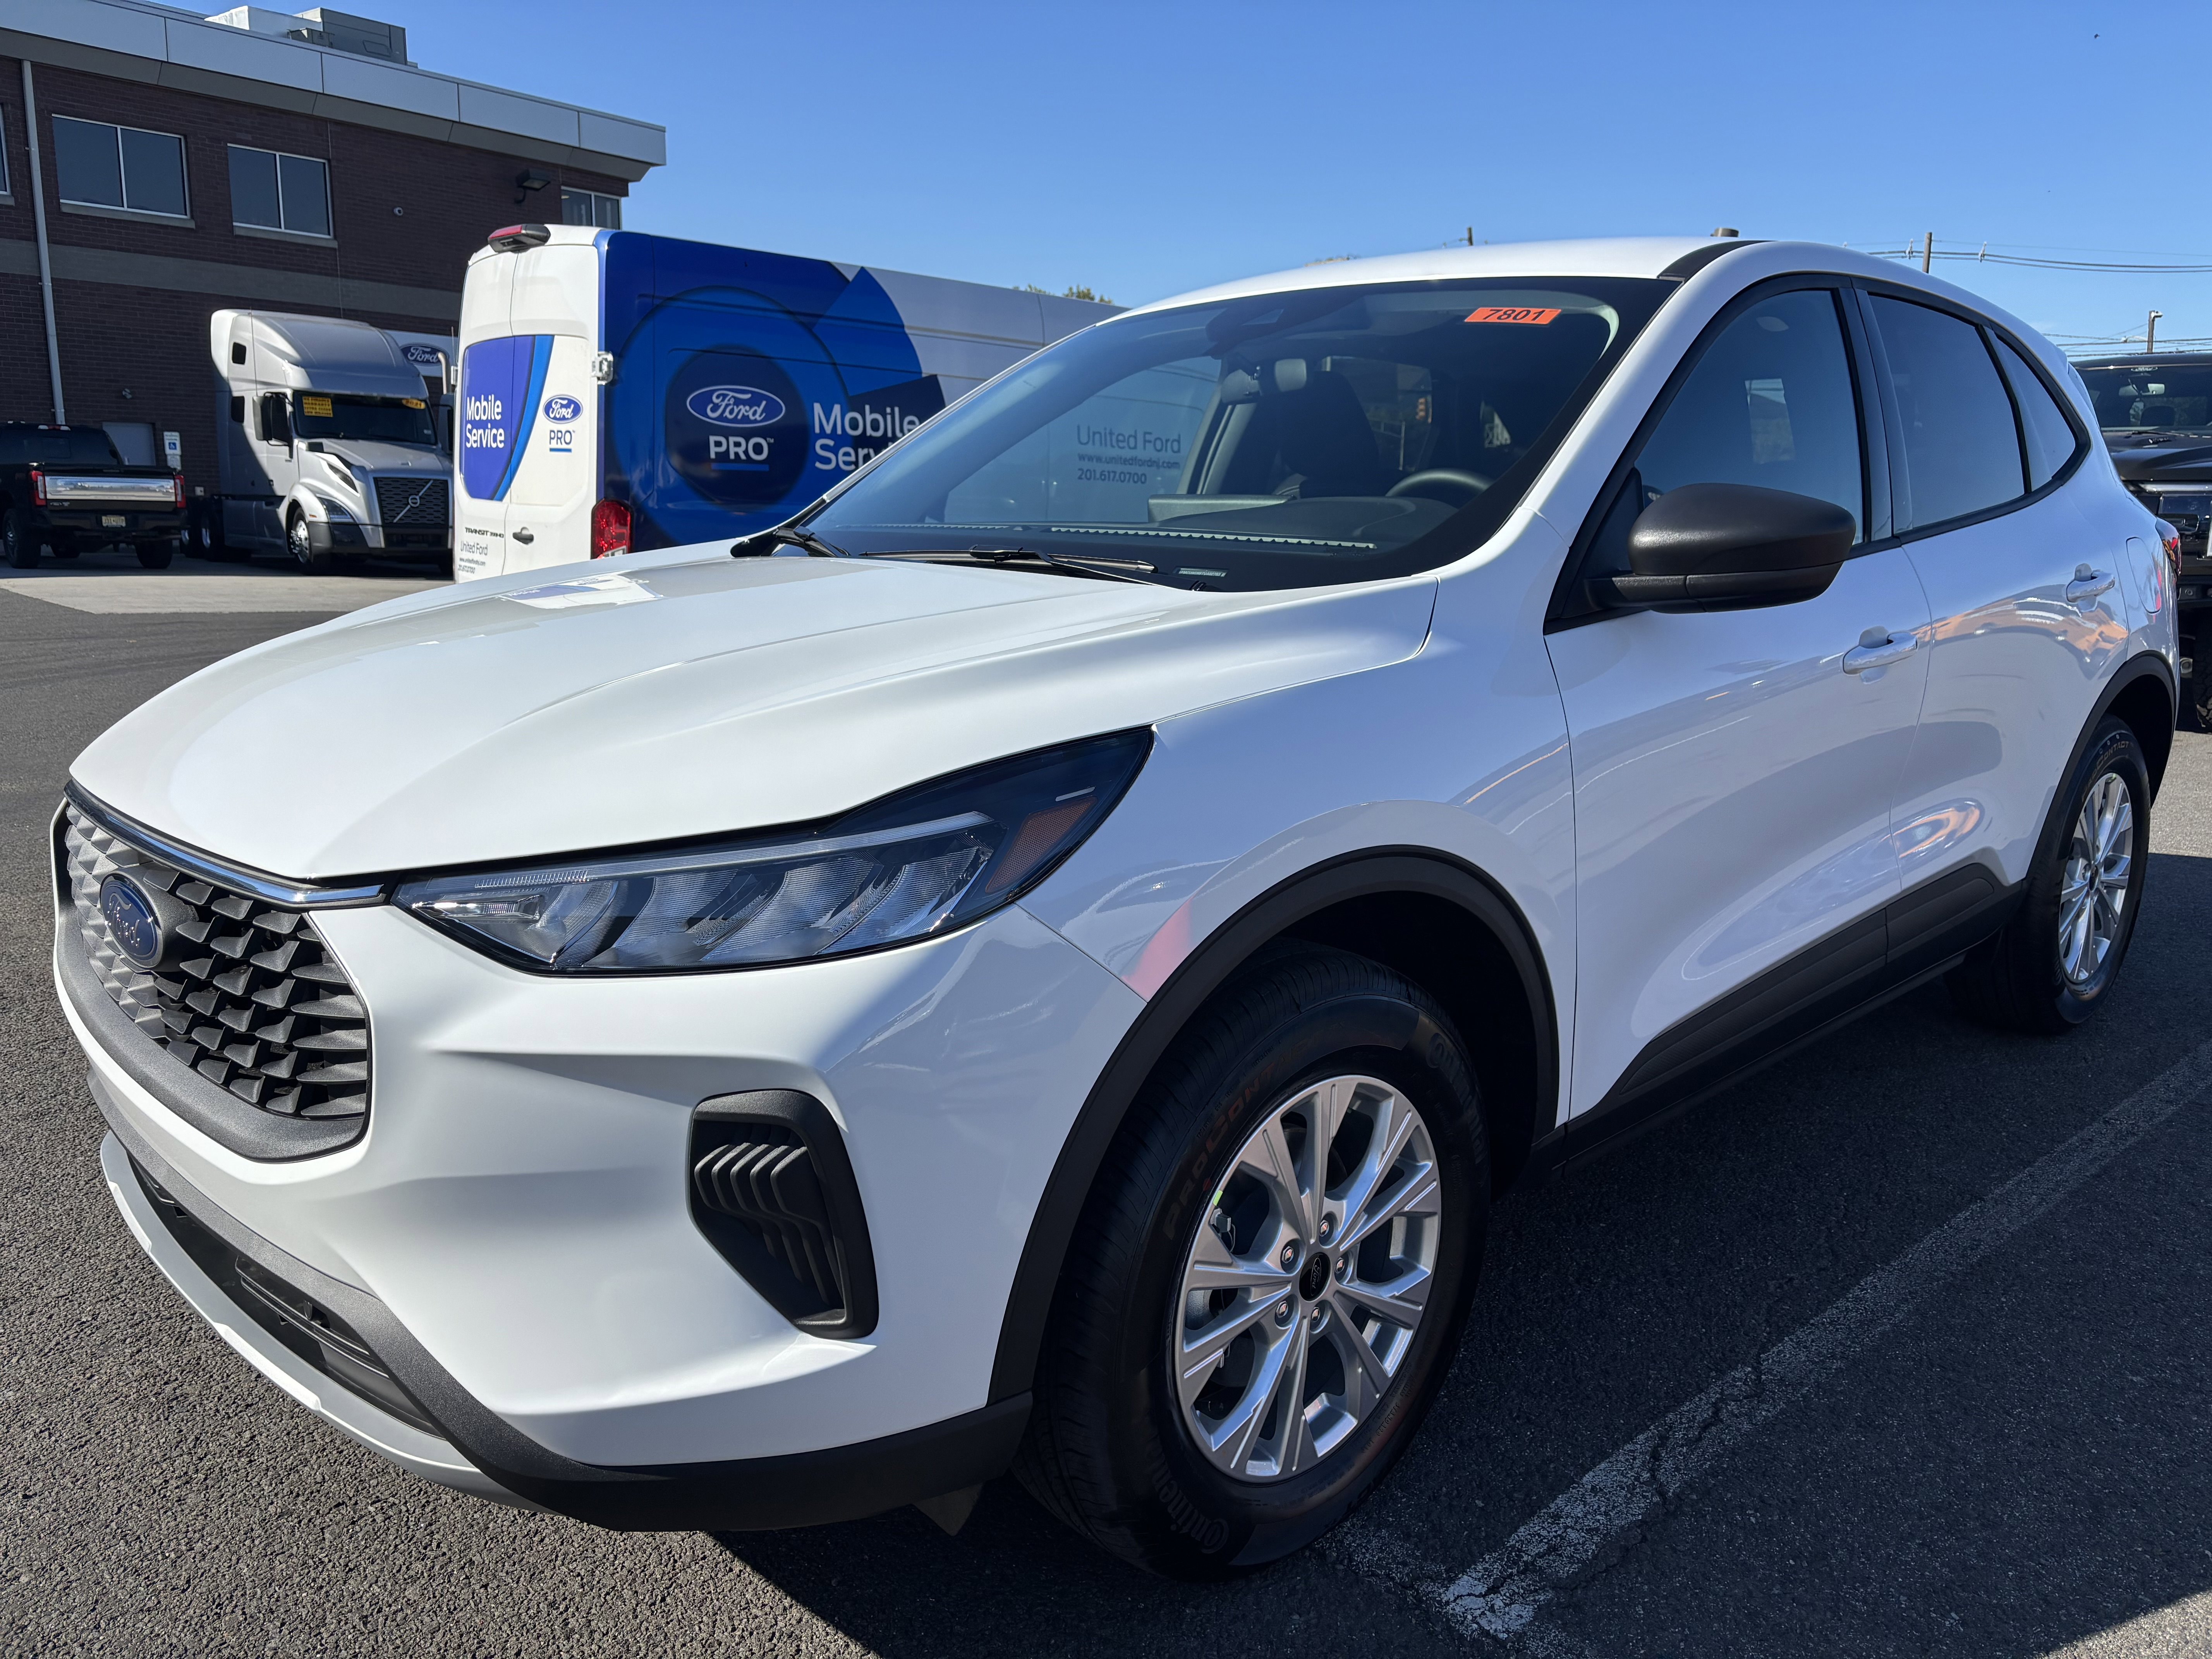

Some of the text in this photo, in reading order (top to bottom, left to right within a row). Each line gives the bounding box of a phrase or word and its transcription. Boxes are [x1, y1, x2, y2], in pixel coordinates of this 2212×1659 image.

[1483, 309, 1546, 321] 7801
[407, 346, 438, 363] Ford
[466, 394, 502, 421] Mobile
[549, 398, 574, 419] Ford
[706, 390, 766, 421] Ford
[813, 402, 920, 438] Mobile
[465, 423, 505, 448] Service
[1077, 424, 1181, 453] United Ford
[1077, 453, 1180, 469] www.unitedfordnj.com
[1077, 468, 1147, 484] 201.617.0700
[460, 541, 488, 556] United Ford
[107, 892, 140, 948] Ford
[1312, 1265, 1320, 1289] Ford
